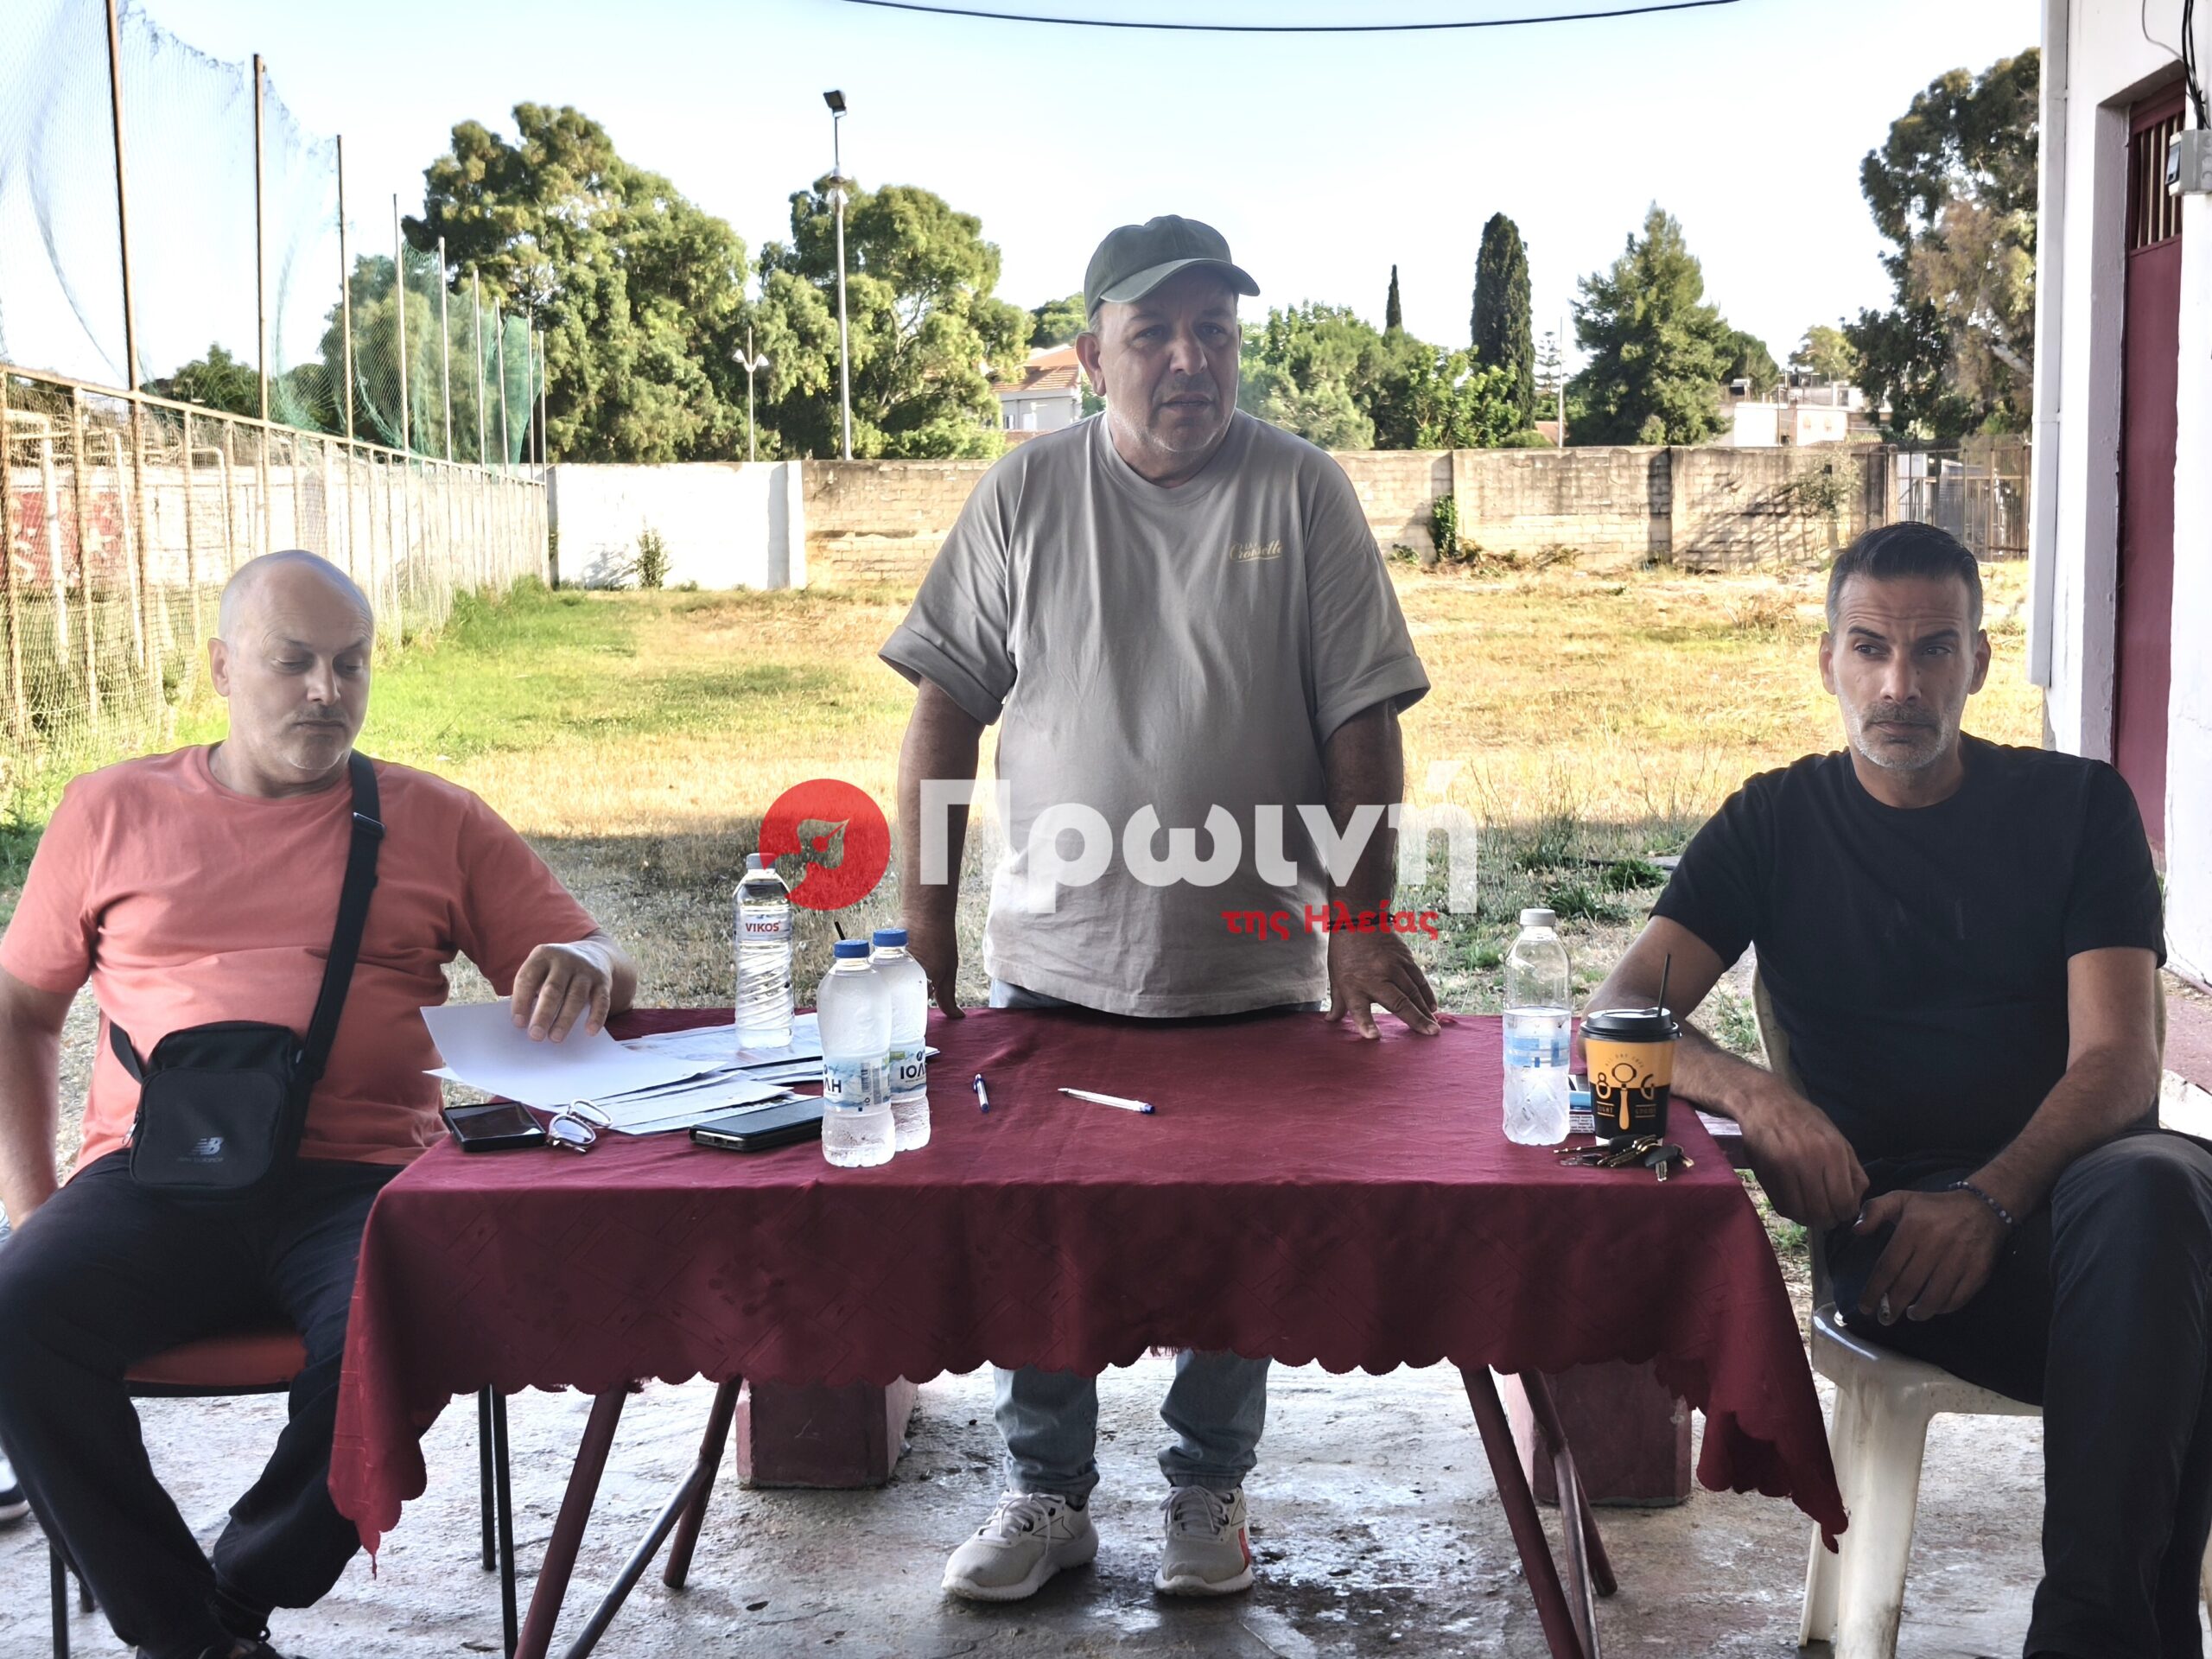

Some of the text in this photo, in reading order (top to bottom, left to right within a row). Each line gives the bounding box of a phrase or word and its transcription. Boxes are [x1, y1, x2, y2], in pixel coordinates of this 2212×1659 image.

[745, 922, 779, 932] VIKOS
[900, 1062, 925, 1080] ΙΟΛ
[824, 1077, 842, 1094] ΛΗ
